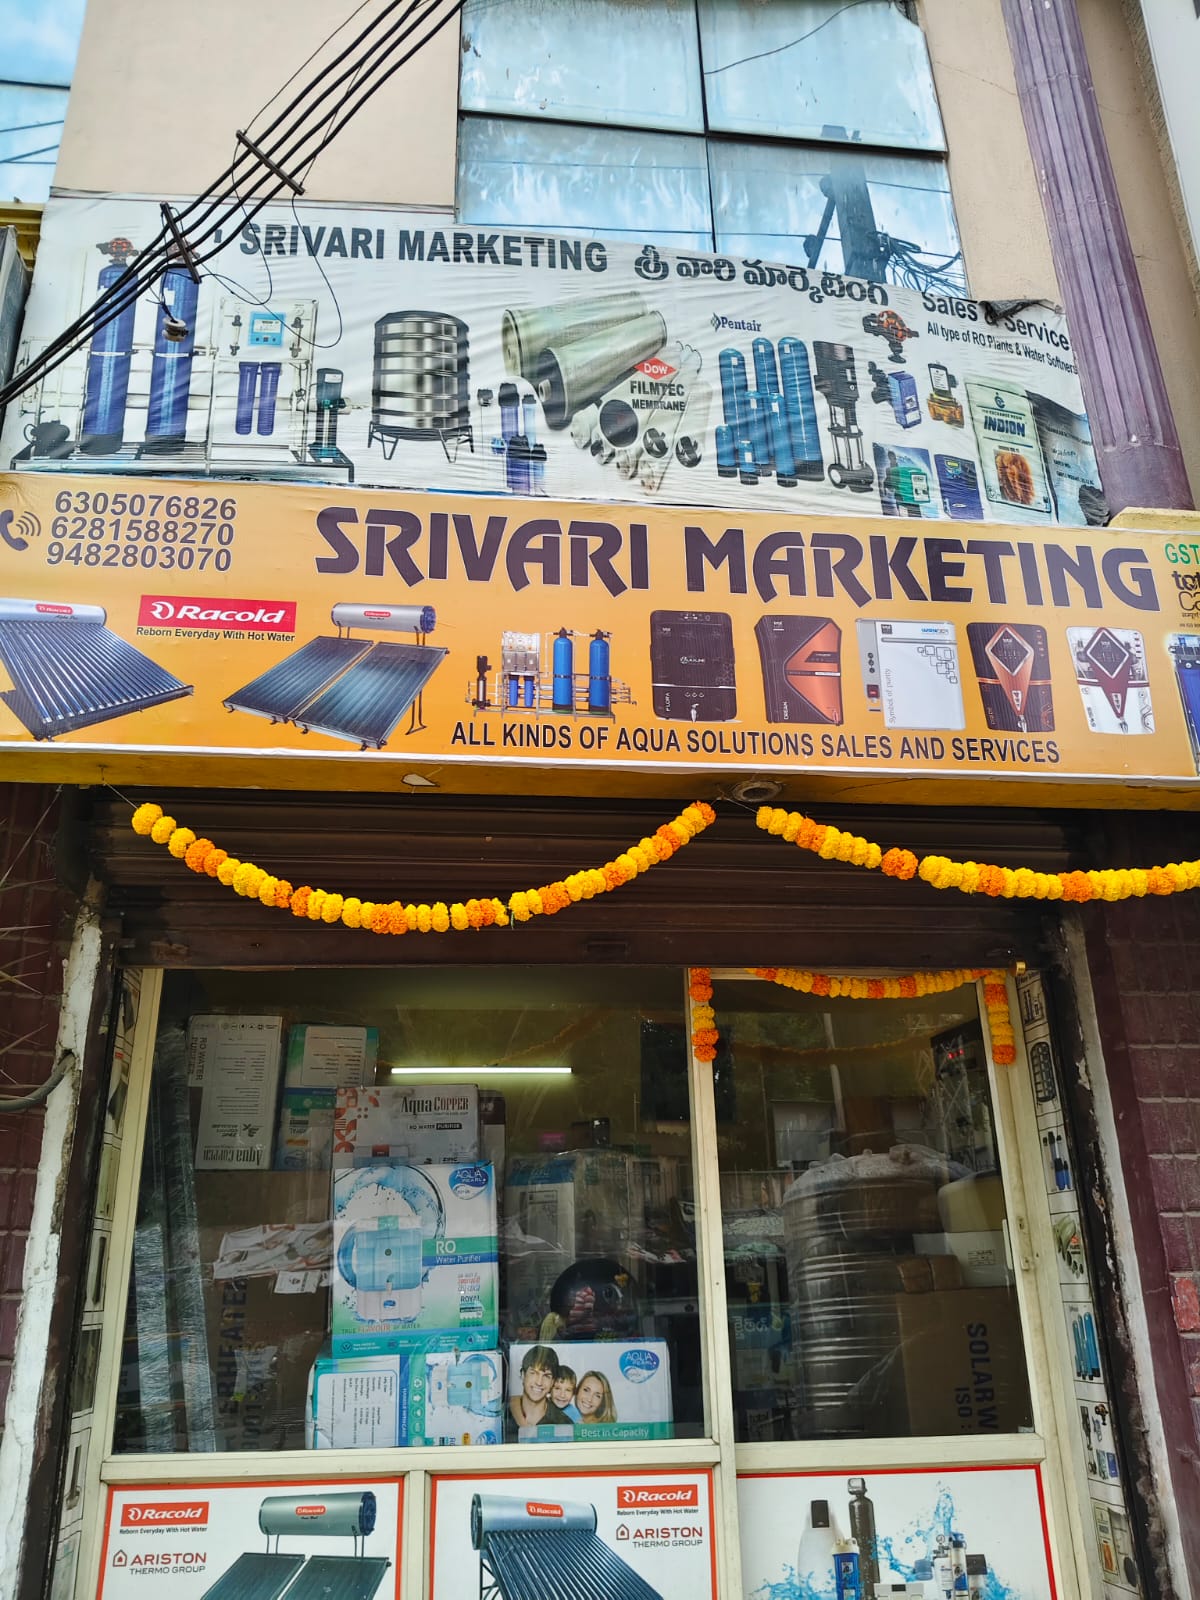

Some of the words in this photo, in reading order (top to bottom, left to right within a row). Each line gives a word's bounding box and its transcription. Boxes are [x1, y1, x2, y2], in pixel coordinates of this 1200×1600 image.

[239, 223, 384, 259] SRIVARI
[399, 229, 608, 272] MARKETING
[634, 245, 669, 281] శ్రీ
[676, 256, 736, 282] వారి
[721, 316, 762, 332] Pentair
[922, 292, 978, 321] Sales
[1004, 316, 1070, 351] Service
[927, 321, 939, 336] All
[941, 325, 960, 342] type
[962, 330, 971, 343] of
[972, 331, 986, 346] RO
[987, 335, 1014, 354] Plants
[1015, 342, 1022, 355] &
[1022, 344, 1045, 363] Water
[1046, 353, 1078, 375] Softners
[630, 381, 684, 396] FILMTEC
[632, 399, 685, 412] MEMBRANE
[984, 415, 1026, 437] INDION
[55, 490, 237, 521] 6305076826
[51, 516, 234, 546] 6281588270
[47, 541, 232, 572] 9482803070
[315, 506, 649, 597] SRIVARI
[684, 526, 1161, 611] MARKETING
[1164, 543, 1200, 564] GST
[176, 605, 285, 623] Racold
[136, 627, 172, 637] Reborn
[175, 628, 220, 641] Everyday
[223, 631, 245, 640] With
[248, 632, 264, 641] Hot
[267, 632, 295, 642] Water
[451, 721, 495, 746] ALL
[503, 722, 572, 749] KINDS
[579, 725, 609, 749] OF
[616, 727, 681, 752] AQUA
[687, 729, 814, 757] SOLUTIONS
[821, 734, 892, 759] SALES
[900, 736, 945, 760] AND
[951, 737, 1060, 764] SERVICES
[401, 1096, 432, 1115] Aqua
[455, 1169, 482, 1179] AQUA
[436, 1240, 456, 1254] RO
[436, 1256, 456, 1264] Water
[458, 1254, 481, 1263] Purifier
[626, 1351, 653, 1361] AQUA
[581, 1429, 600, 1438] Best
[602, 1428, 610, 1437] in
[612, 1428, 649, 1439] Capacity
[637, 1490, 692, 1502] Racold
[142, 1507, 203, 1519] Racold
[140, 1527, 164, 1535] Everyday
[633, 1526, 702, 1539] ARISTON
[632, 1540, 670, 1548] THERMO
[672, 1539, 703, 1547] GROUP
[130, 1552, 206, 1566] ARISTON
[129, 1566, 170, 1575] THERMO
[171, 1565, 206, 1574] GROUP
